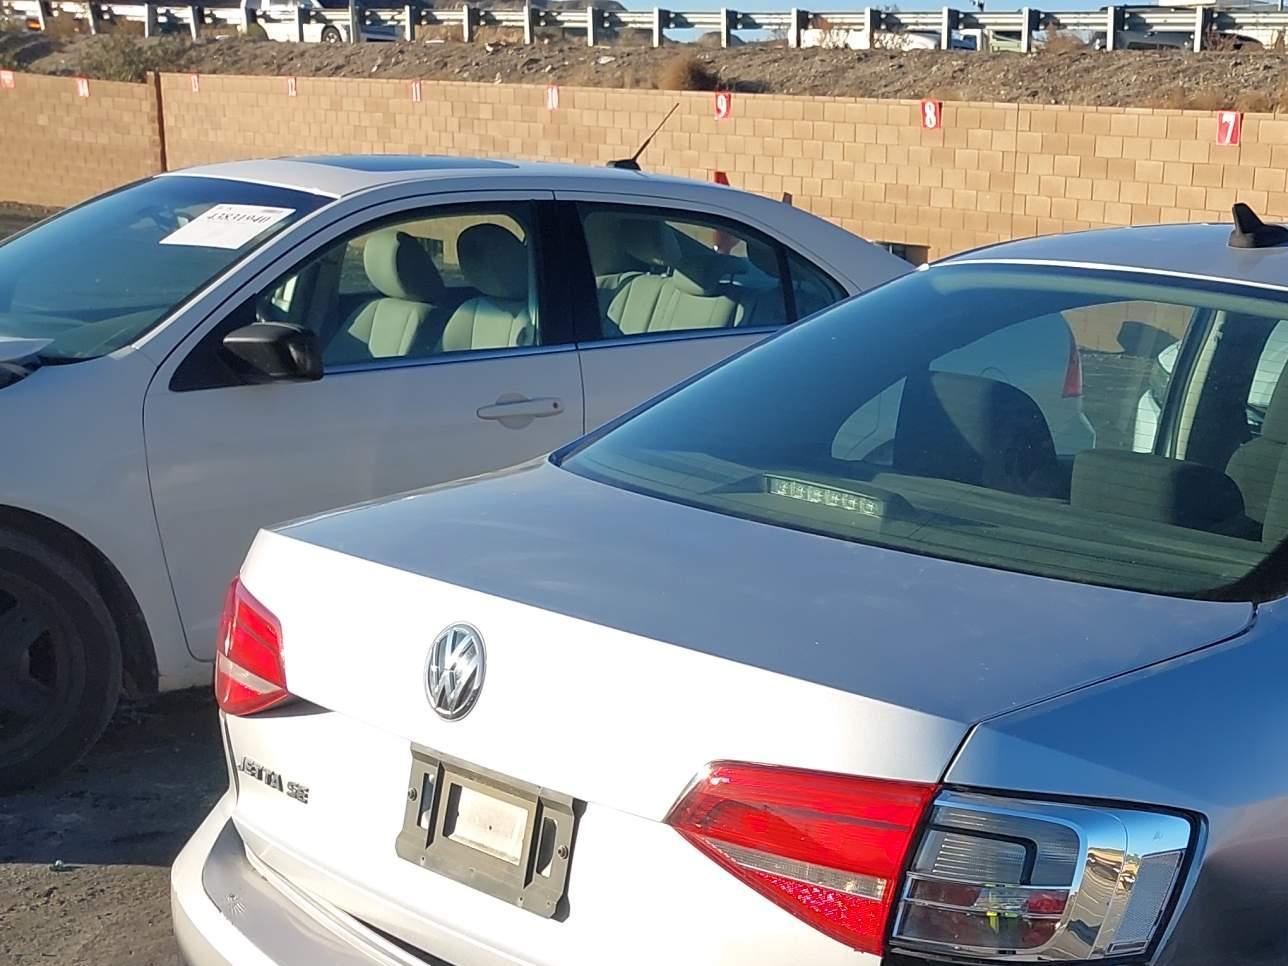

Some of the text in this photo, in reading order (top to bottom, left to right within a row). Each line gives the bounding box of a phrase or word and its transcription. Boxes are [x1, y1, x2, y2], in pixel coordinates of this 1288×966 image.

[411, 81, 421, 101] 11
[547, 87, 559, 110] 10
[714, 95, 727, 119] 9
[924, 101, 937, 128] 8
[1221, 111, 1236, 144] 7
[237, 756, 310, 805] JETTA SE
